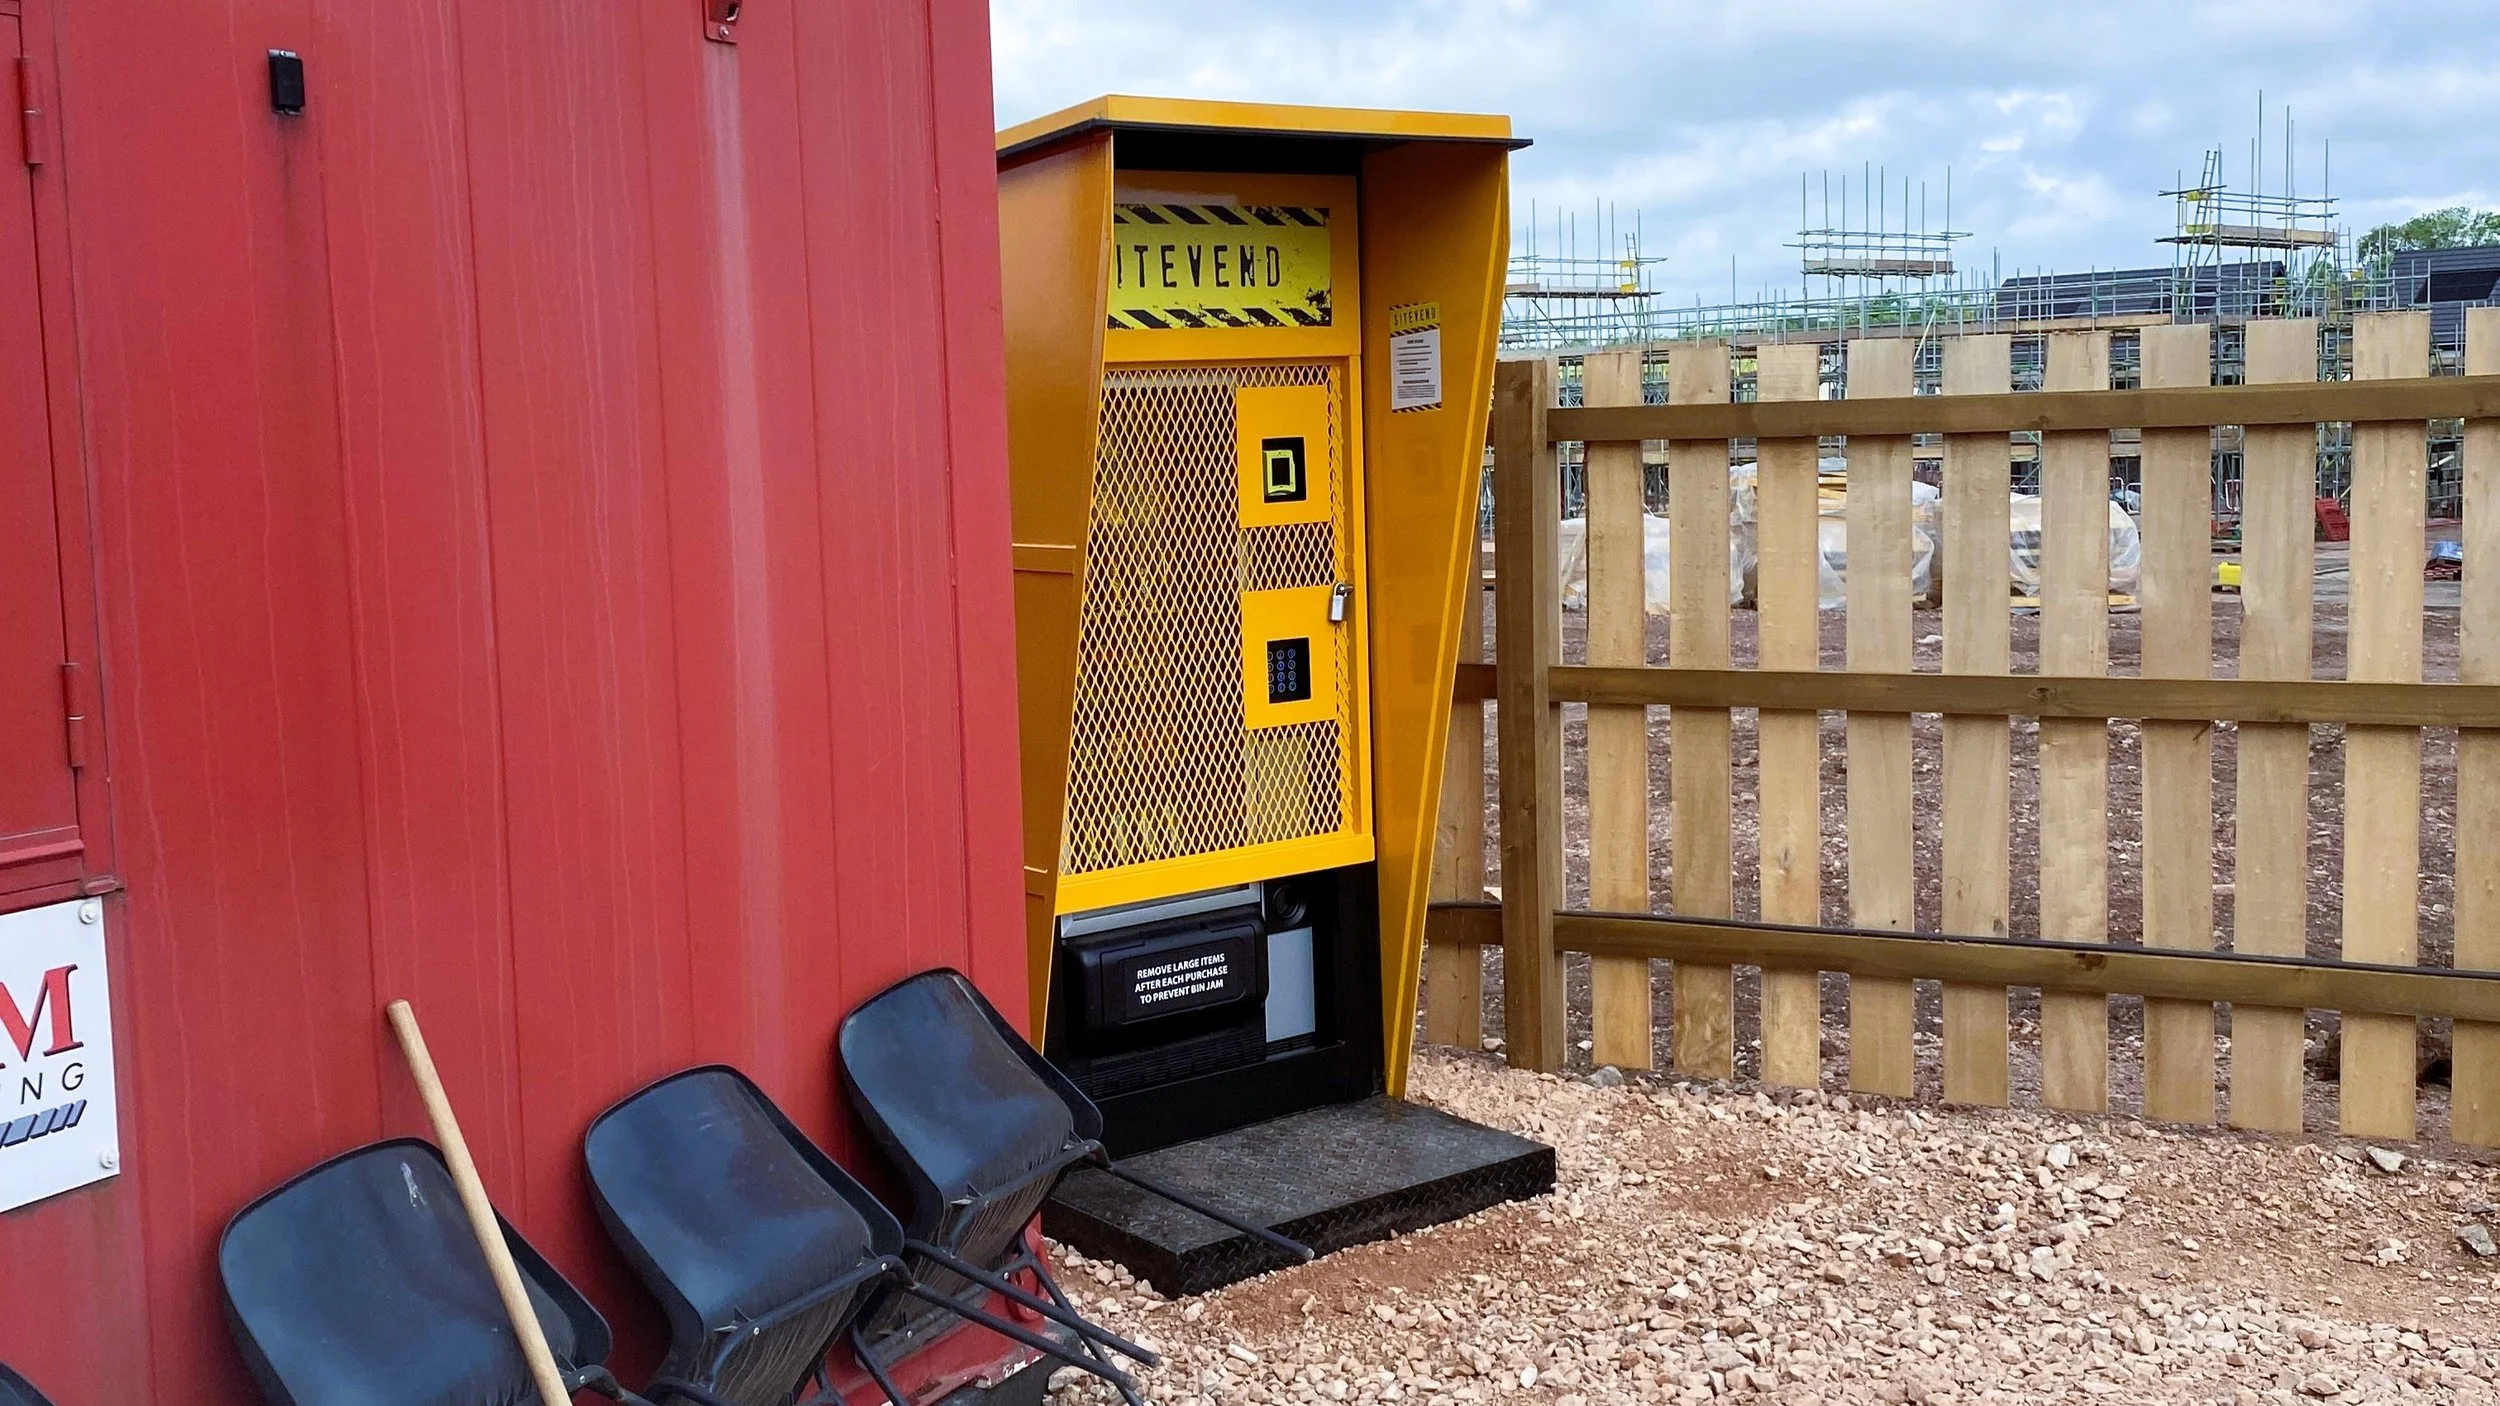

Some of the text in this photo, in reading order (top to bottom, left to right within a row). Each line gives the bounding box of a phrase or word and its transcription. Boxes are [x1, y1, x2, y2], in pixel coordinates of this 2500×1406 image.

[1116, 244, 1281, 288] ITEVEND
[1393, 307, 1436, 326] SITEVEND
[1135, 965, 1228, 993] AFTER EACH PURCHASE
[1137, 953, 1225, 979] REMOVE LARGE ITEMS
[1140, 979, 1224, 1004] TO PREVENT BIN JAM
[20, 1062, 85, 1105] NG
